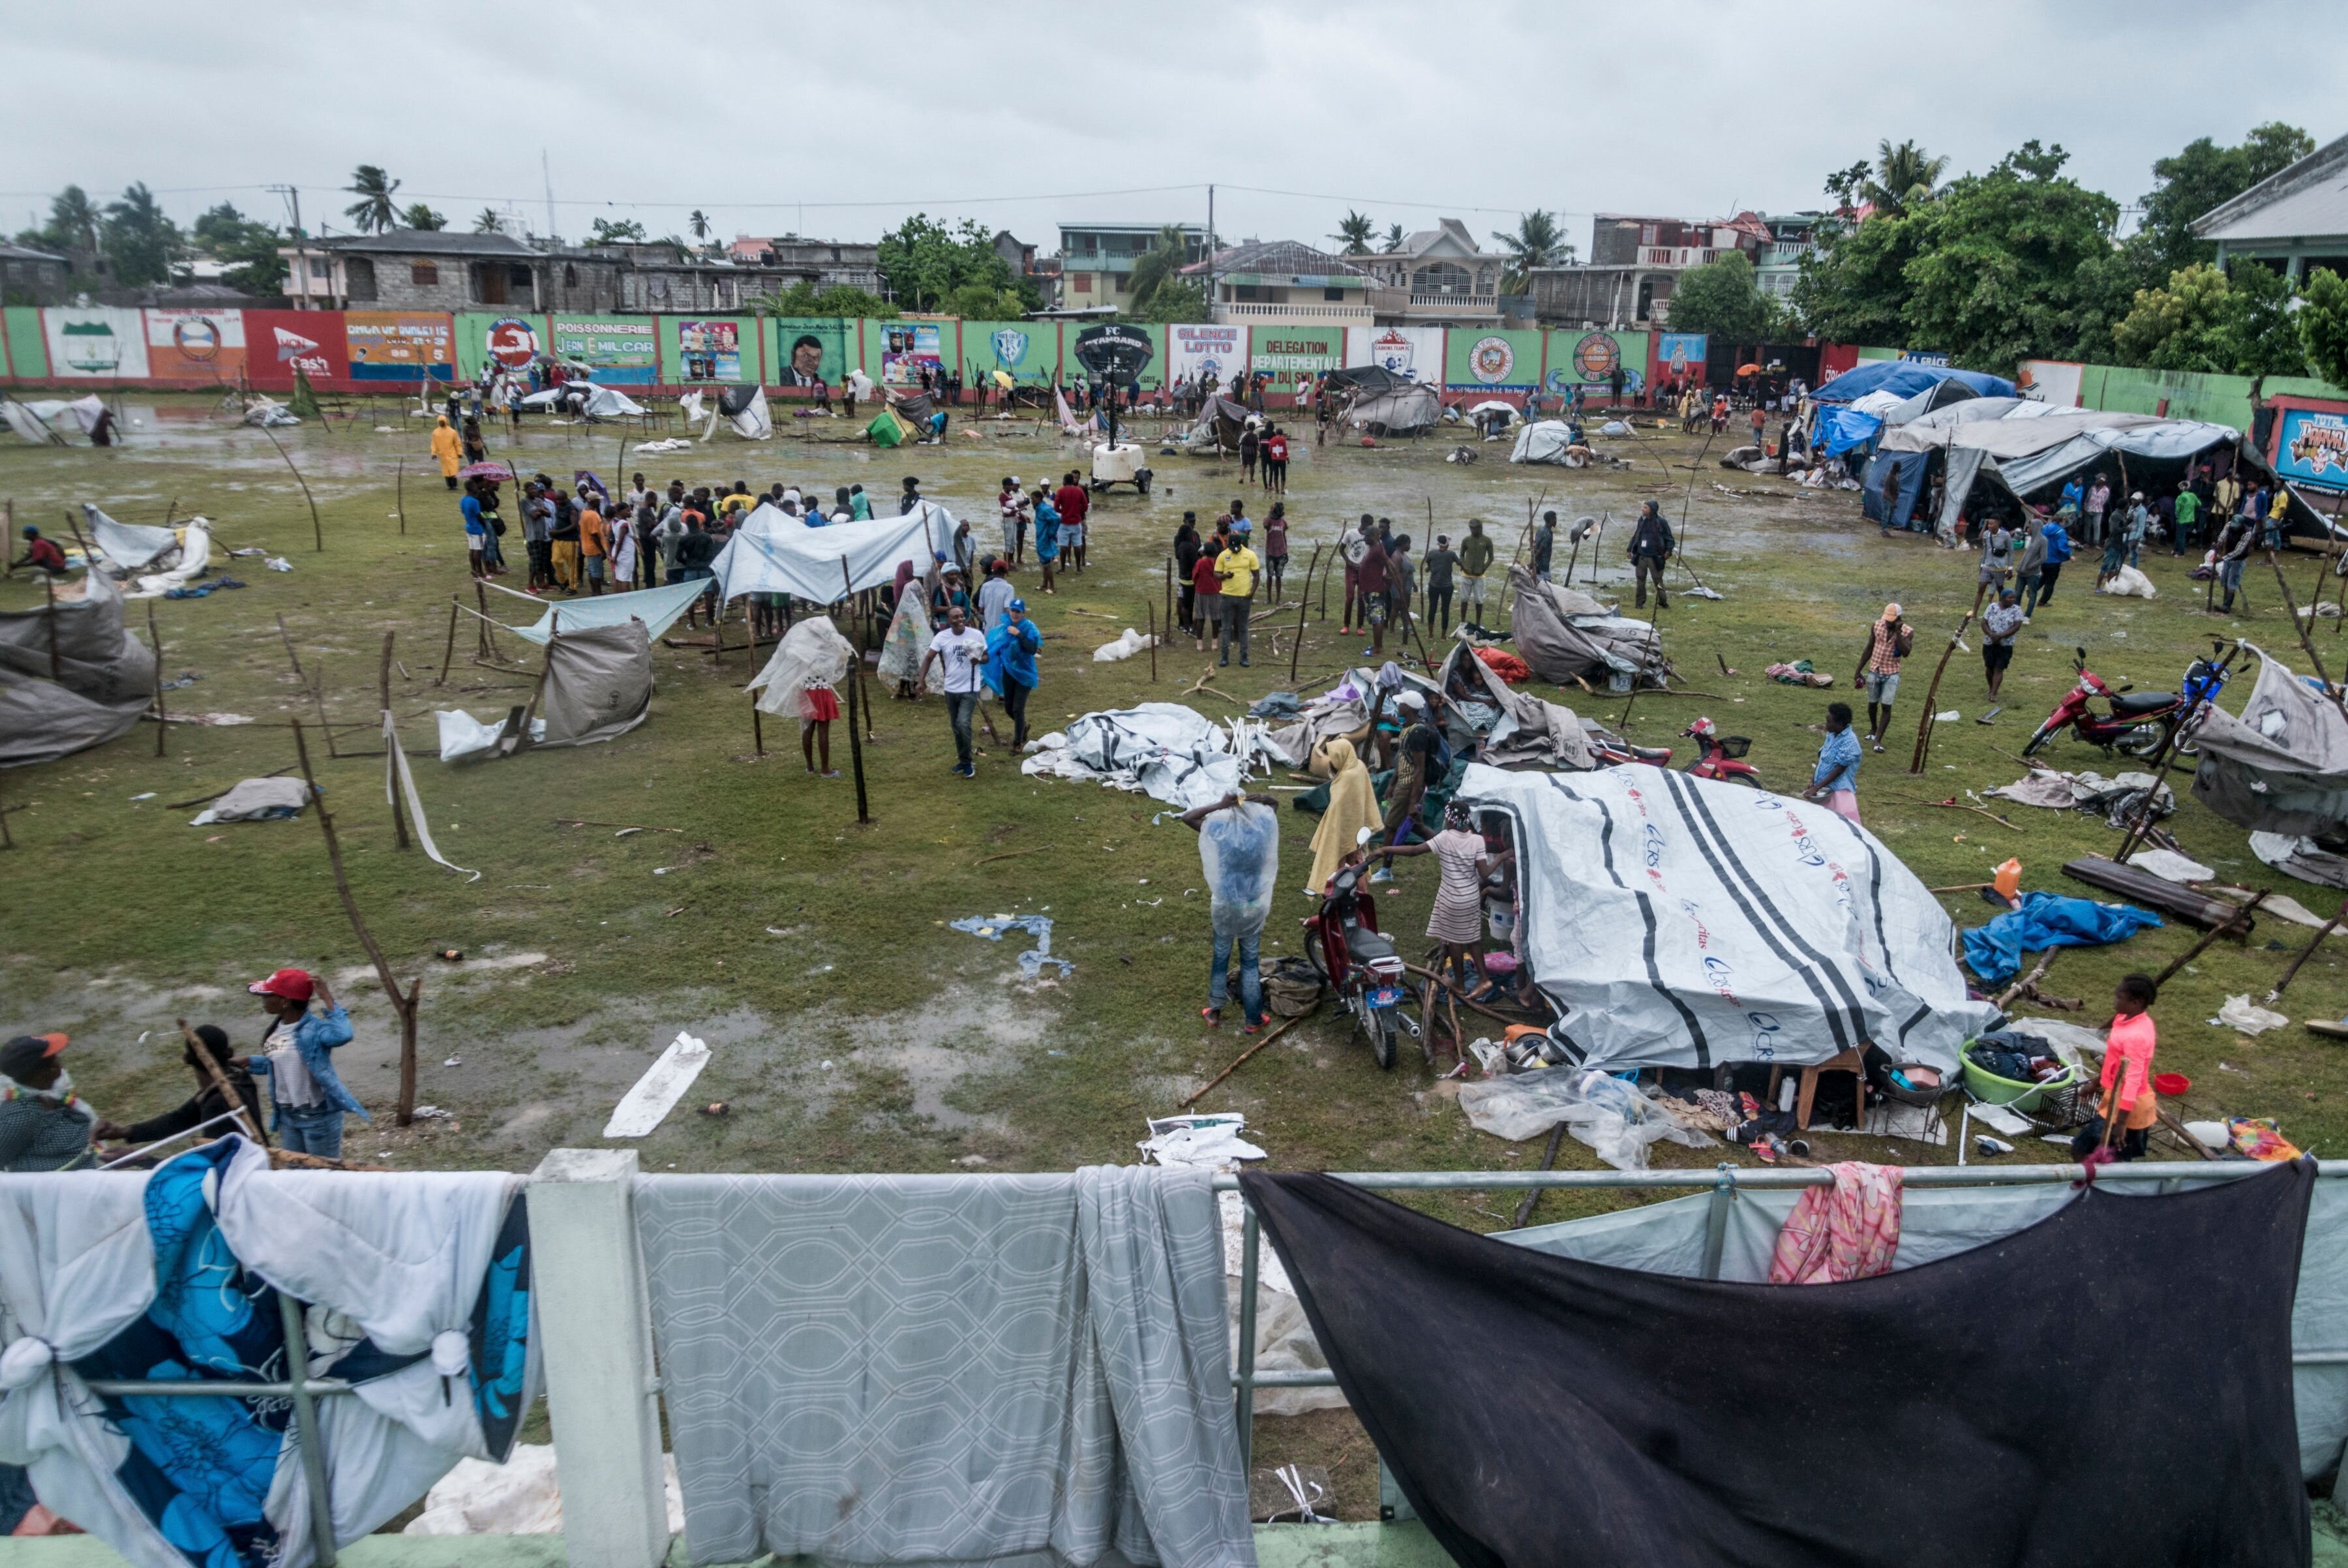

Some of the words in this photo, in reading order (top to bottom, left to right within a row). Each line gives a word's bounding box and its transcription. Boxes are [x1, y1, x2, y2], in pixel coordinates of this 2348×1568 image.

[556, 322, 653, 335] POISSONNERIE
[1104, 326, 1121, 335] FC
[1177, 327, 1237, 340] SILENCE
[280, 339, 305, 349] MON
[587, 337, 654, 354] EMILCAR
[1184, 341, 1232, 353] LOTTO
[433, 349, 445, 361] 5
[290, 355, 328, 369] Cash
[1251, 355, 1342, 369] DEPARTEMENTALE
[1278, 371, 1291, 384] DU
[1514, 387, 1526, 397] Peyi
[2314, 414, 2343, 428] TOTAL
[1794, 836, 1817, 856] CRS
[1647, 839, 1660, 869] CRS
